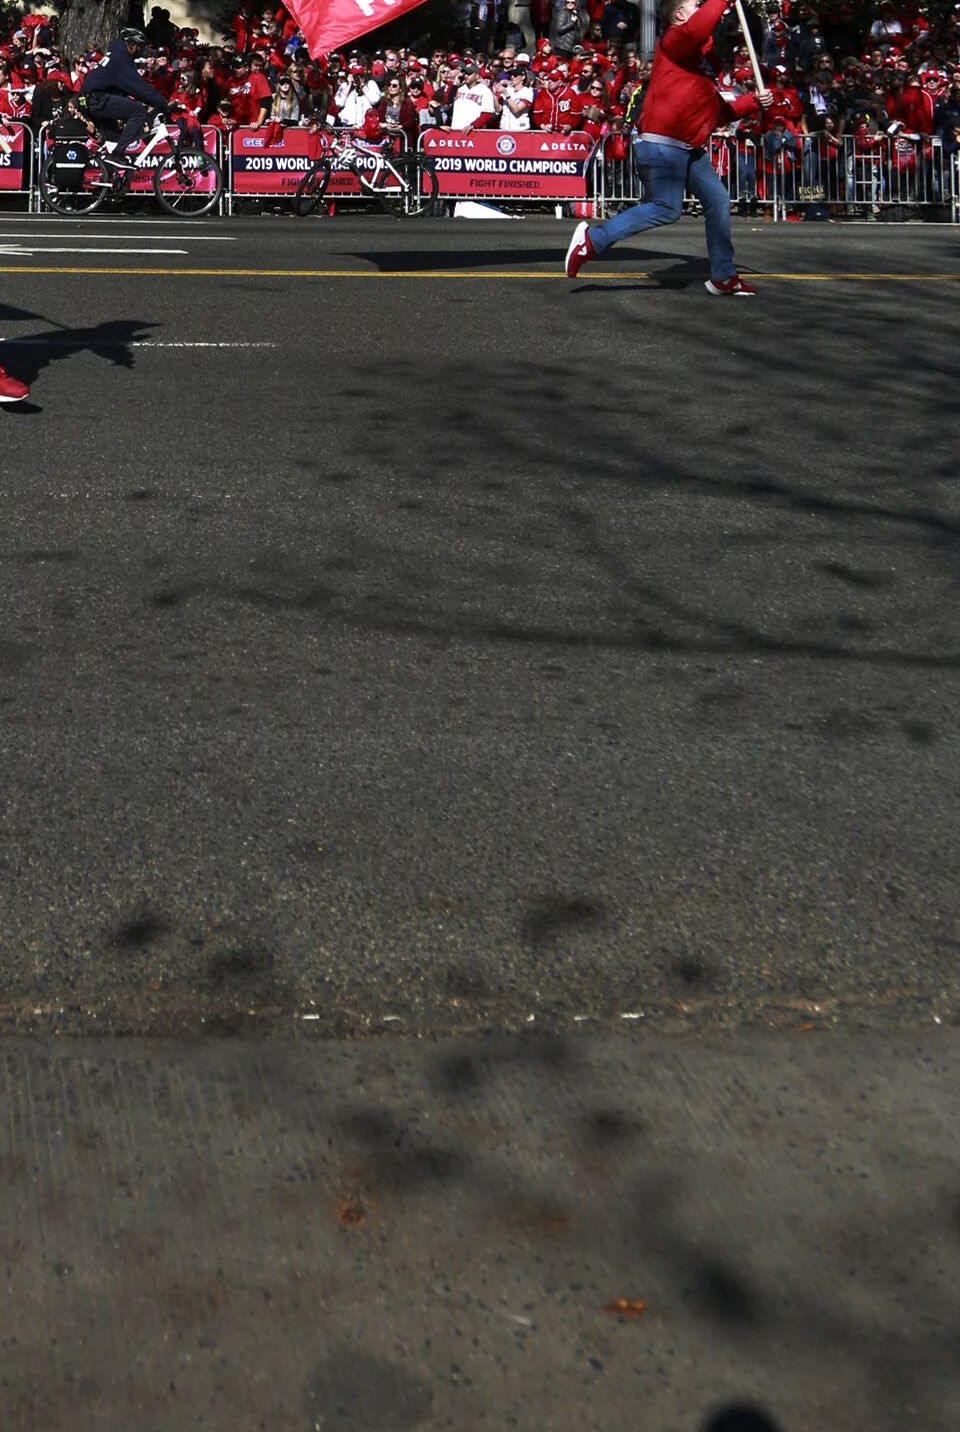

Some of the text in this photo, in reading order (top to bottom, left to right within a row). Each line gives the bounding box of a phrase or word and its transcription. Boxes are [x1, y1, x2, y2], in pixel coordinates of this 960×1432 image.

[439, 139, 475, 148] DELTA
[551, 142, 587, 152] DELTA
[245, 157, 273, 170] 2019
[275, 158, 314, 171] WORL
[434, 157, 578, 174] 2019 WORLD CHAMPIONS
[281, 177, 302, 186] FIGH
[470, 178, 496, 188] FIGHT
